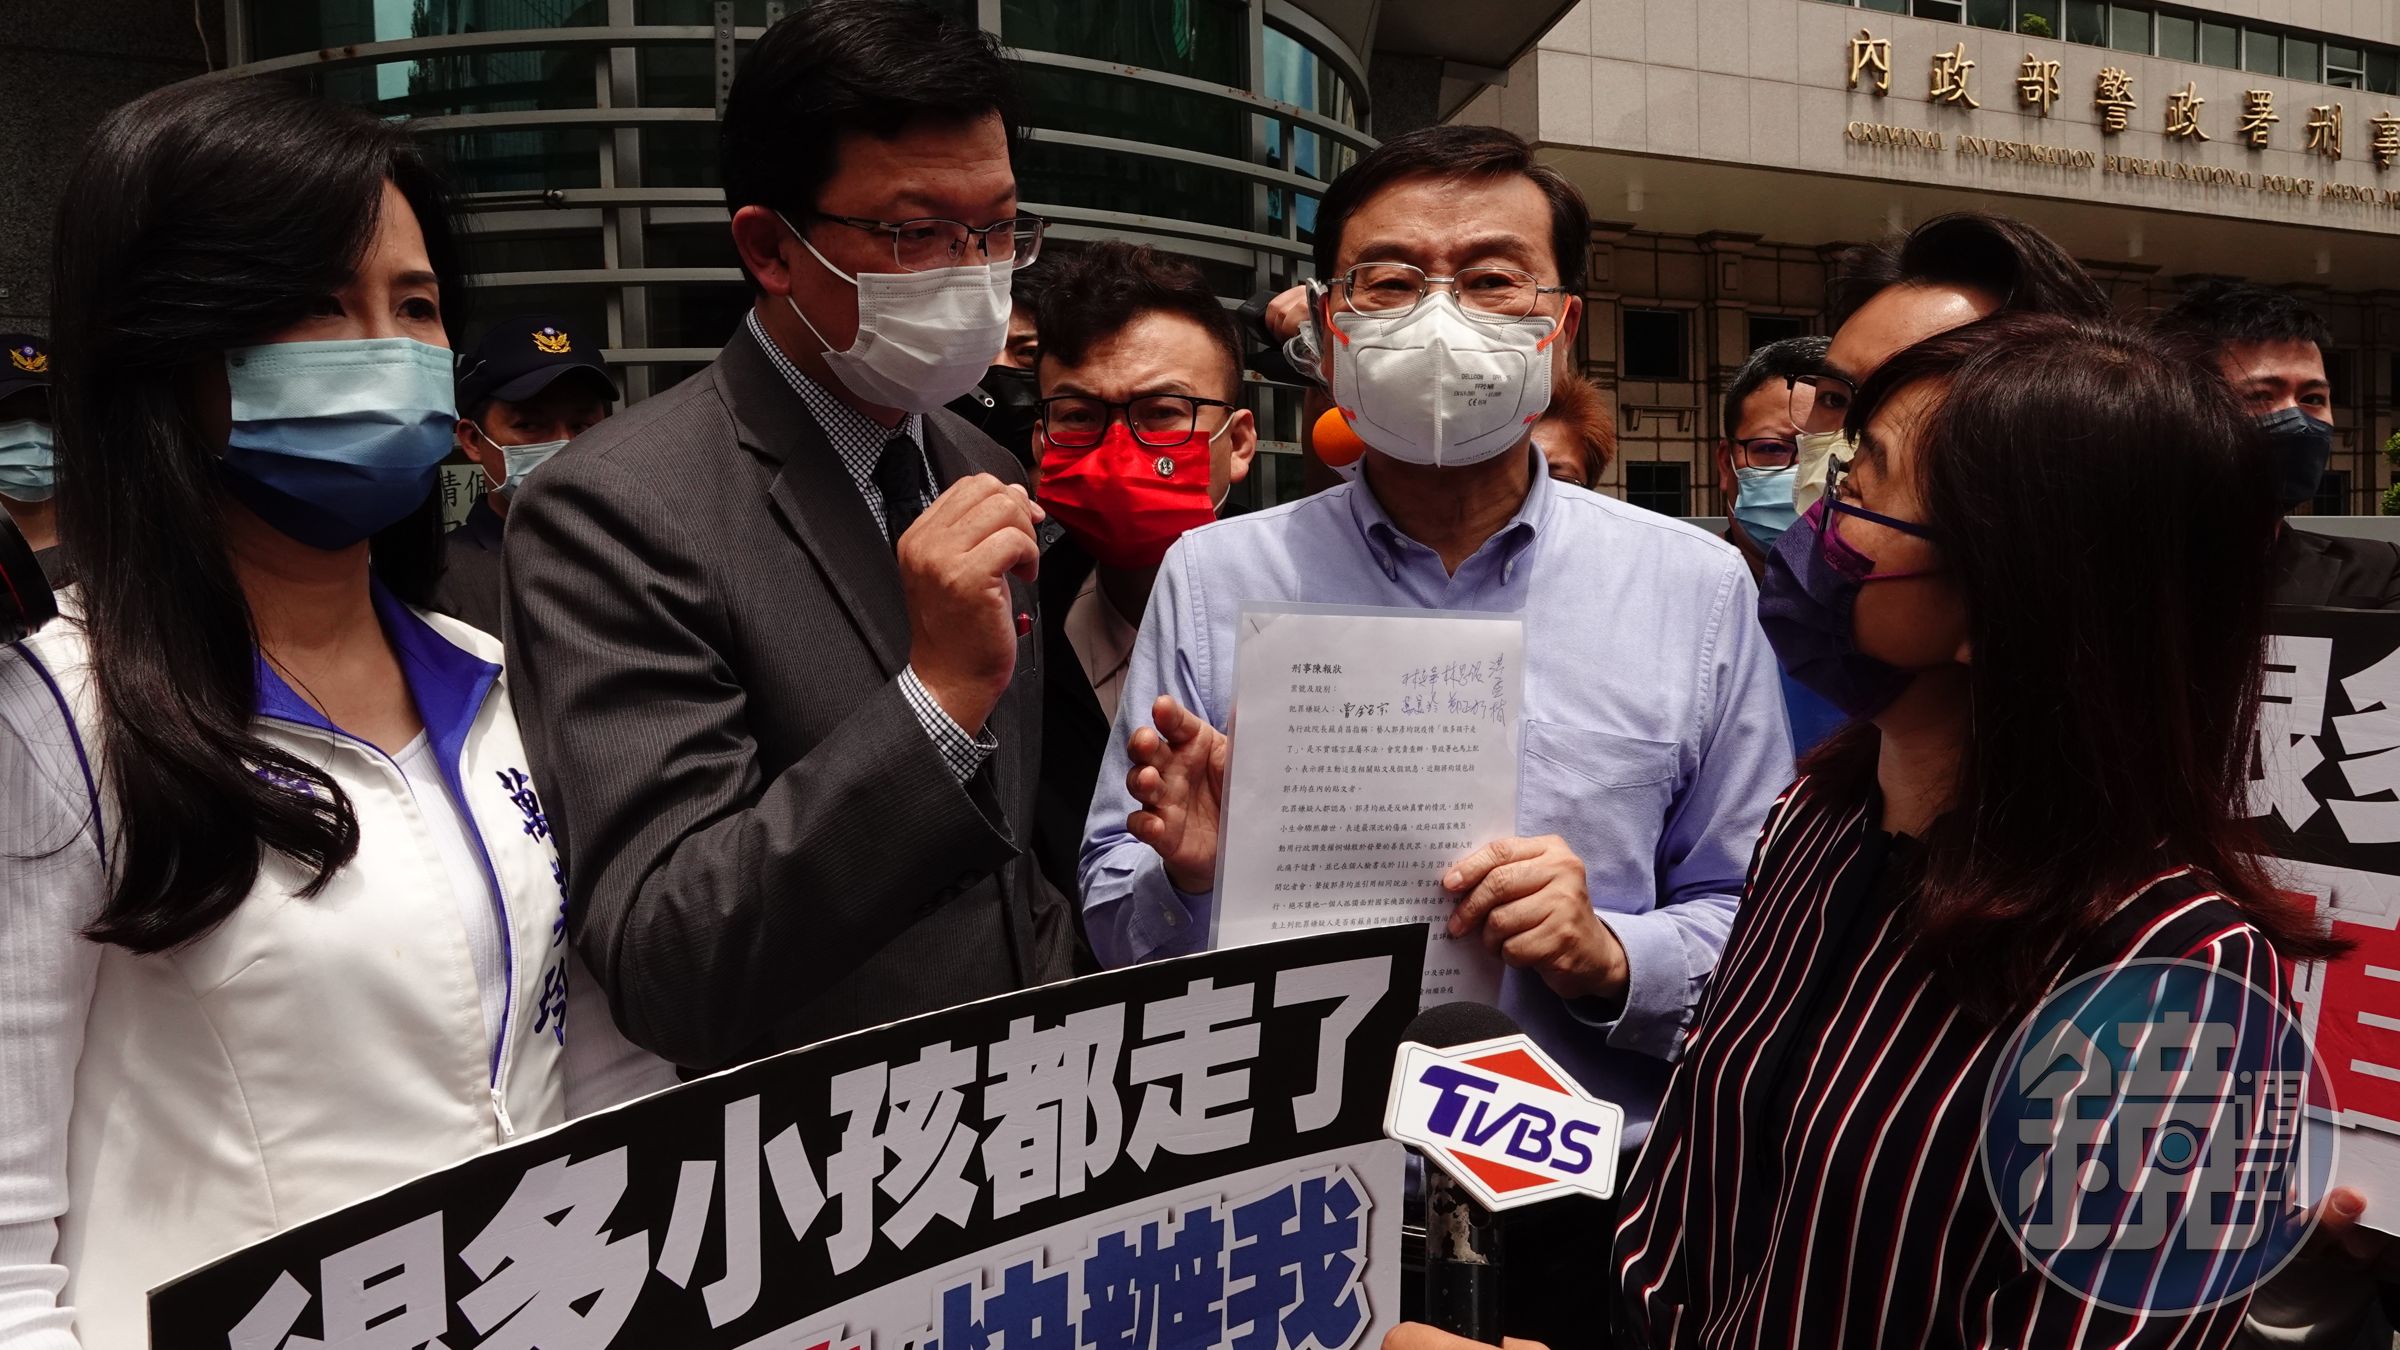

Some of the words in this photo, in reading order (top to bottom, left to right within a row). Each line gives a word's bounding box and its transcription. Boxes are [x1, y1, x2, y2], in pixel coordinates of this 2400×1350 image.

[1849, 28, 2400, 170] 內政部警政署刑事
[1847, 121, 1947, 151] CRIMINAL
[1957, 135, 2095, 168] INVESTIGATION
[2261, 174, 2315, 196] POLICE
[1291, 663, 1343, 674] 刑事陳報狀
[228, 955, 1392, 1350] 很多小孩都走了
[1419, 1065, 1600, 1174] TVBS
